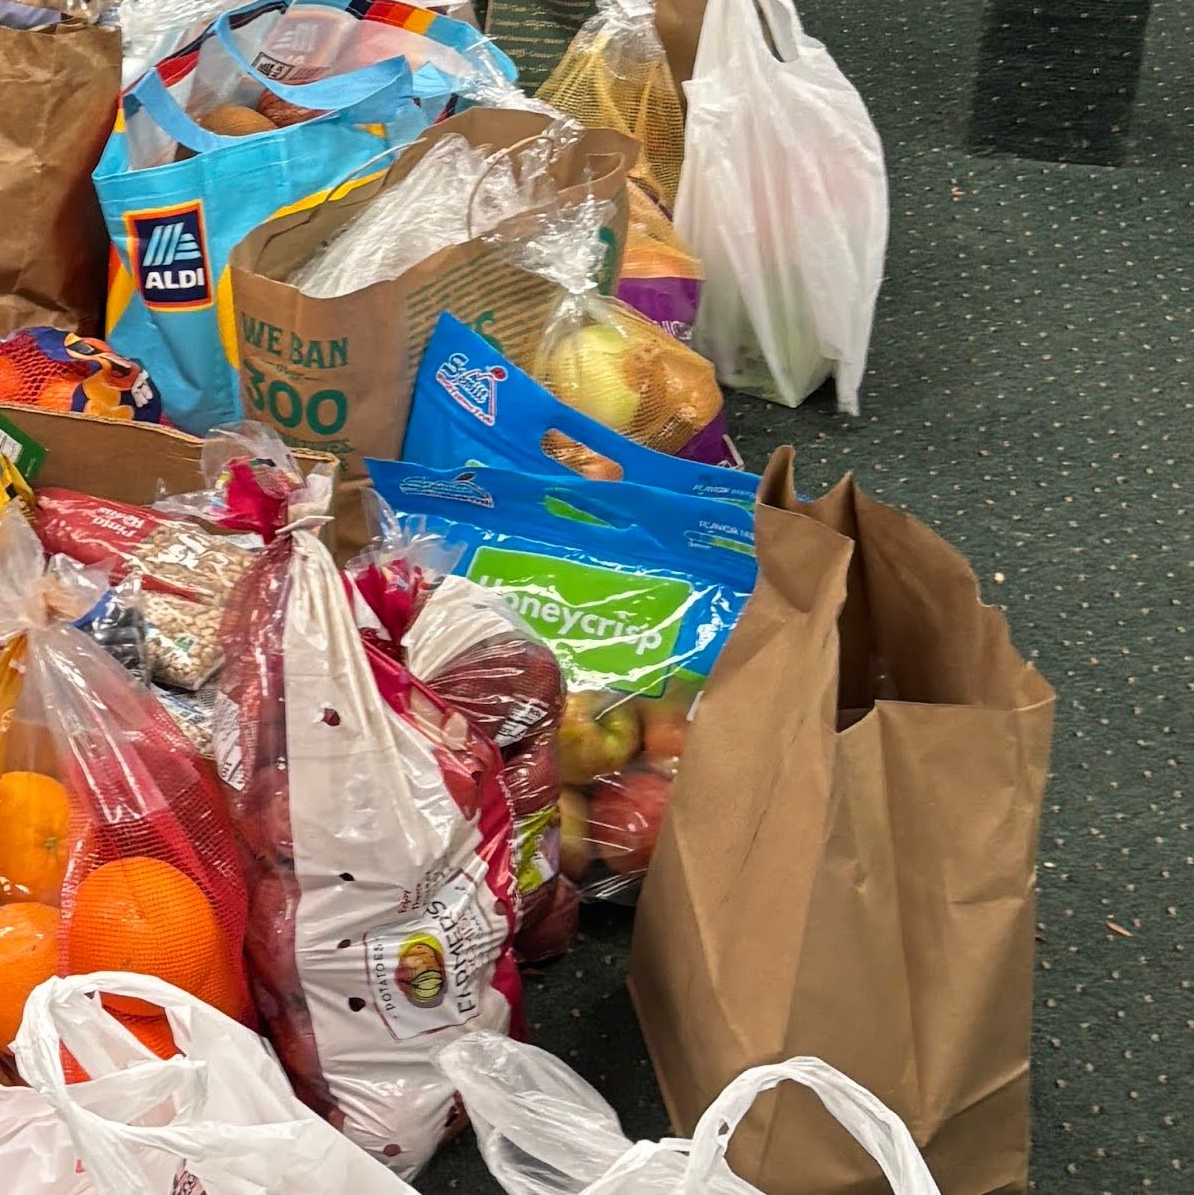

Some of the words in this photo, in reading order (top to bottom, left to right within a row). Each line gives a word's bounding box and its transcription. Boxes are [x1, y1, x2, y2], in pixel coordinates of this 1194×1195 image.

[145, 268, 205, 289] ALDI
[241, 310, 284, 357] WE
[289, 332, 349, 370] BAN
[242, 358, 349, 436] 300
[91, 516, 138, 538] Pinto
[478, 573, 664, 657] Honeycrisp
[373, 942, 398, 1012] POTATOES
